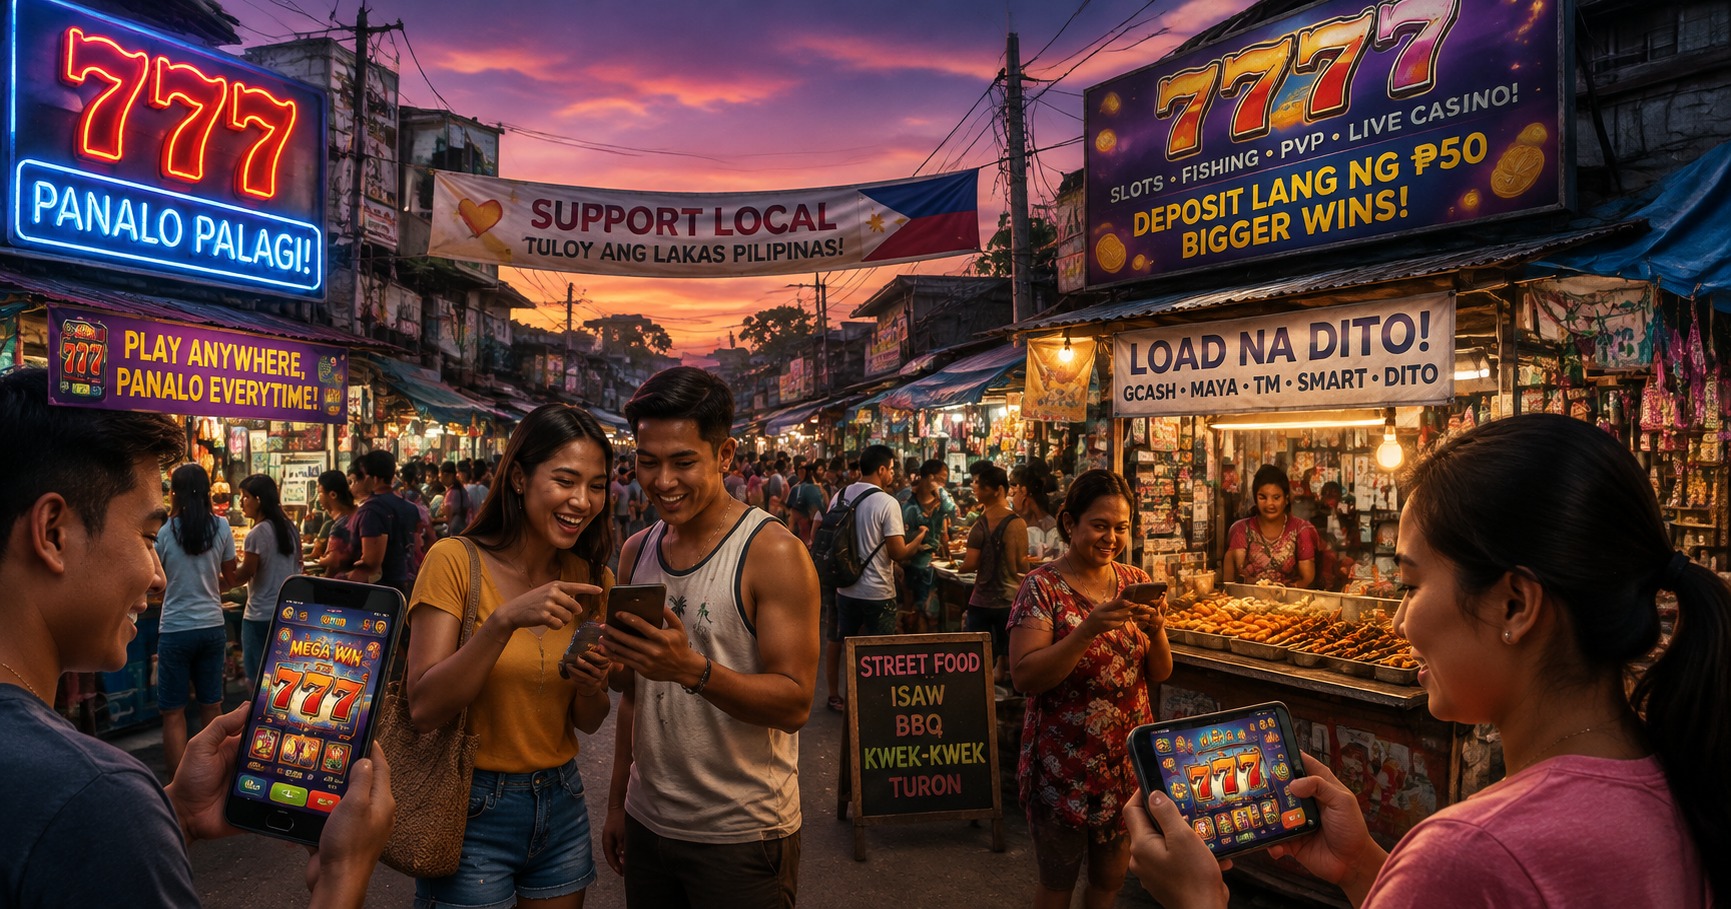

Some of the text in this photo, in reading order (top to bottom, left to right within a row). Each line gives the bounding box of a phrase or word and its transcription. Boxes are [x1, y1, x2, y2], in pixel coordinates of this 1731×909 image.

[1155, 0, 1462, 162] 7777
[60, 27, 298, 200] 777
[1110, 175, 1164, 204] SLOTS
[1280, 131, 1324, 159] PVP
[1349, 111, 1403, 142] LIVE
[1410, 82, 1519, 126] CASINO!
[1133, 187, 1245, 238] DEPOSIT
[1251, 165, 1338, 211] LANG
[1348, 151, 1400, 190] NG
[31, 180, 312, 275] PANALO PALAGI!
[531, 198, 838, 237] SUPPORT LOCAL
[1182, 185, 1409, 260] BIGGER WINS!
[523, 236, 844, 264] TULOY ANG LAKAS PILIPINAS!
[63, 341, 105, 376] 777
[124, 329, 306, 381] PLAY ANYWHERE,
[1130, 310, 1431, 376] LOAD NA DITO!
[116, 367, 204, 402] PANALO
[208, 376, 319, 411] EVERYTIME!
[1123, 362, 1439, 402] GCASH MAYA TM SMART DITO
[289, 639, 364, 668] MEGA WIN
[860, 652, 981, 678] STREET FOOD
[272, 668, 365, 722] 777
[890, 684, 946, 708] ISAW
[895, 713, 944, 739] BBQ
[864, 741, 986, 770] KWEK-KWEK
[1187, 749, 1264, 802] 777
[888, 773, 963, 799] TURON
